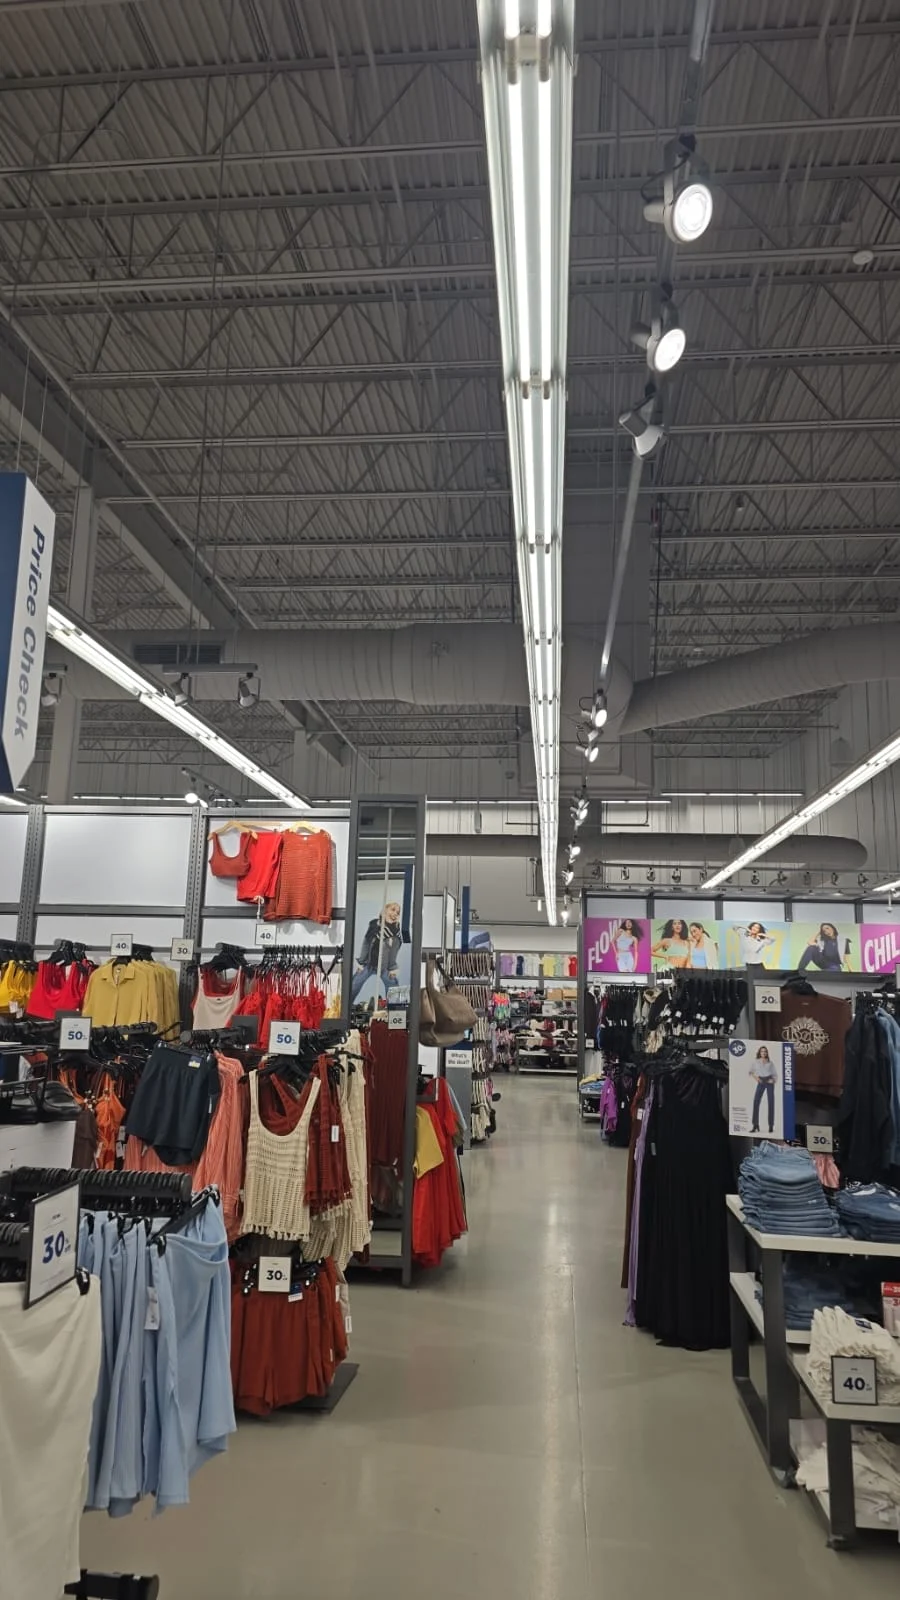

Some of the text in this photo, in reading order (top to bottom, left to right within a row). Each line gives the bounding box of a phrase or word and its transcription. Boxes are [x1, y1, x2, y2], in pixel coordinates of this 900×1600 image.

[14, 525, 45, 740] Price Check
[761, 996, 775, 1004] 20
[67, 1031, 83, 1040] 50
[276, 1034, 292, 1044] 50
[784, 1046, 793, 1084] STRAIGHT
[813, 1136, 826, 1144] 30
[42, 1230, 65, 1264] 30
[266, 1270, 282, 1280] 30
[843, 1377, 865, 1390] 40
